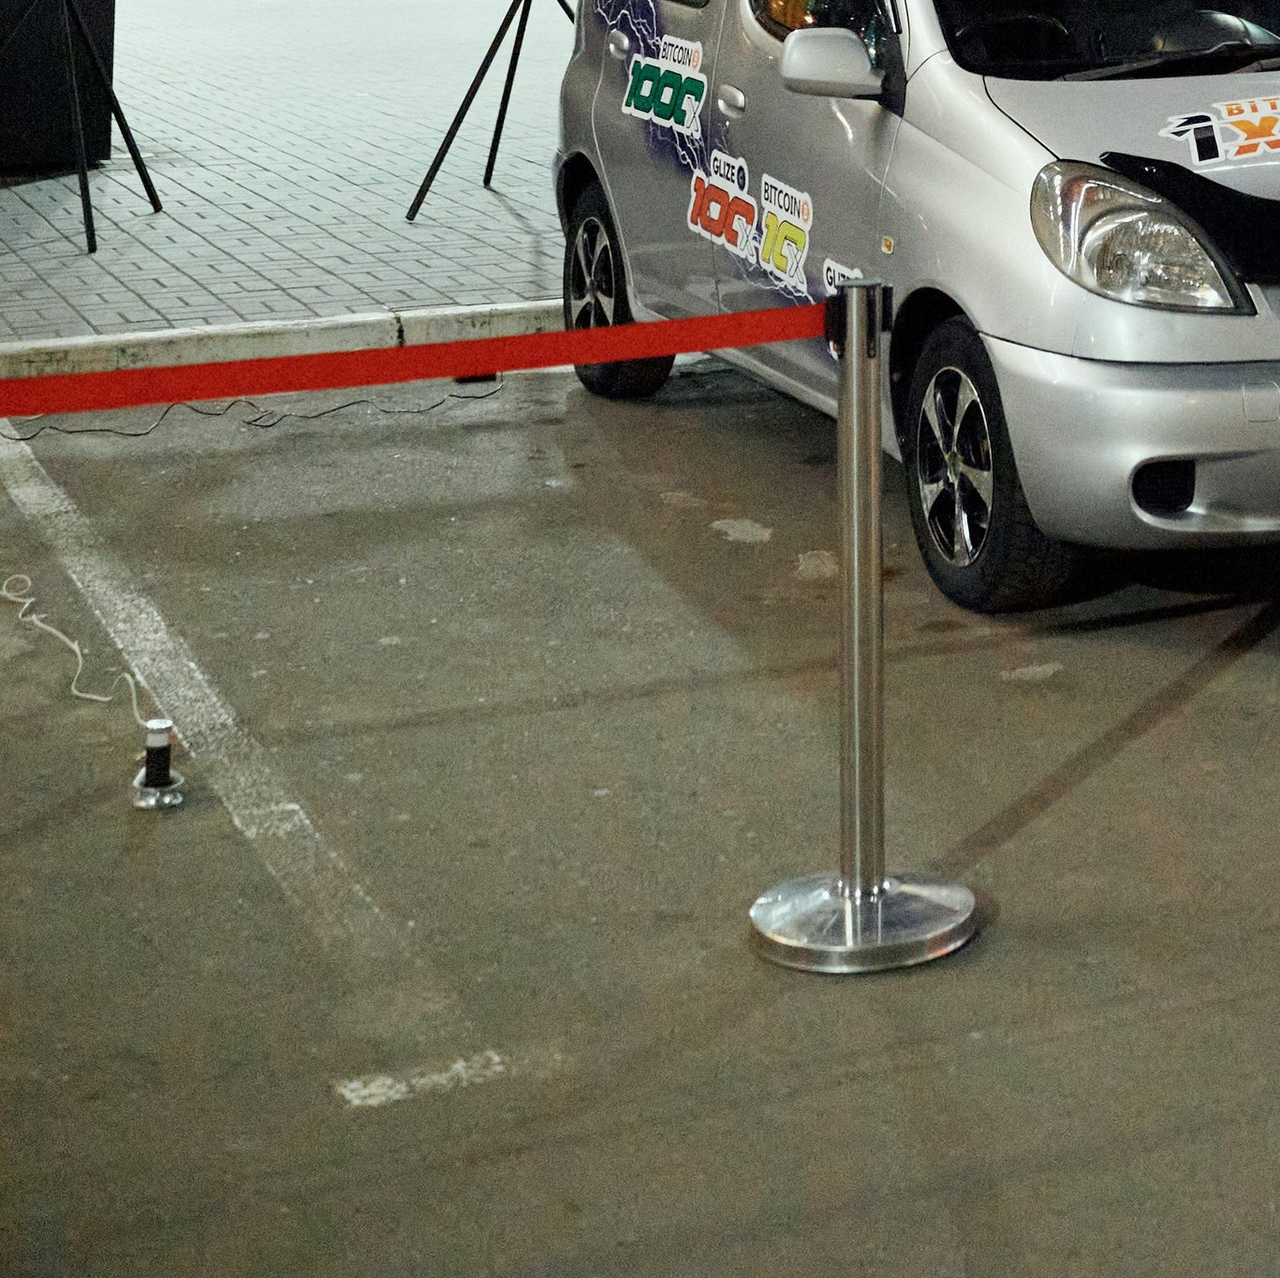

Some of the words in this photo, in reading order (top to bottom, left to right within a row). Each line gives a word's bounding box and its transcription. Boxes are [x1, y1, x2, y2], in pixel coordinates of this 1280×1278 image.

[661, 40, 692, 68] BITCOIN
[712, 156, 736, 184] GLIZE
[763, 180, 802, 219] BITCOIN
